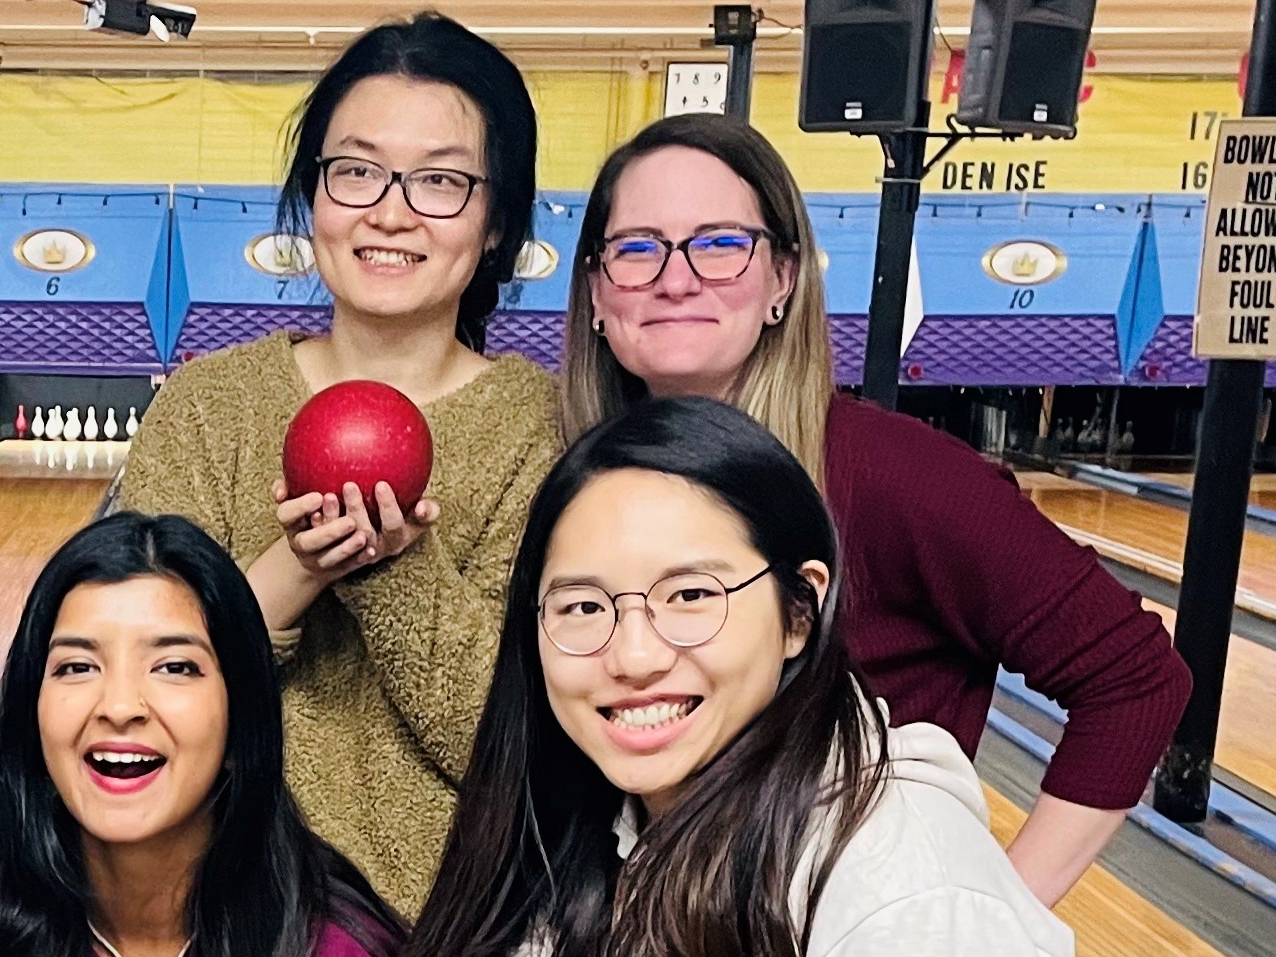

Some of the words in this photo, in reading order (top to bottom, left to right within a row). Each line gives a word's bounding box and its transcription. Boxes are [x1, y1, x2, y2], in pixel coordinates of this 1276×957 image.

[1189, 110, 1229, 140] 17
[1244, 171, 1276, 202] NO
[45, 276, 61, 296] 6
[276, 279, 290, 300] 7
[1008, 288, 1035, 310] 10
[1229, 279, 1275, 309] FOUL
[1228, 315, 1271, 345] LINE
